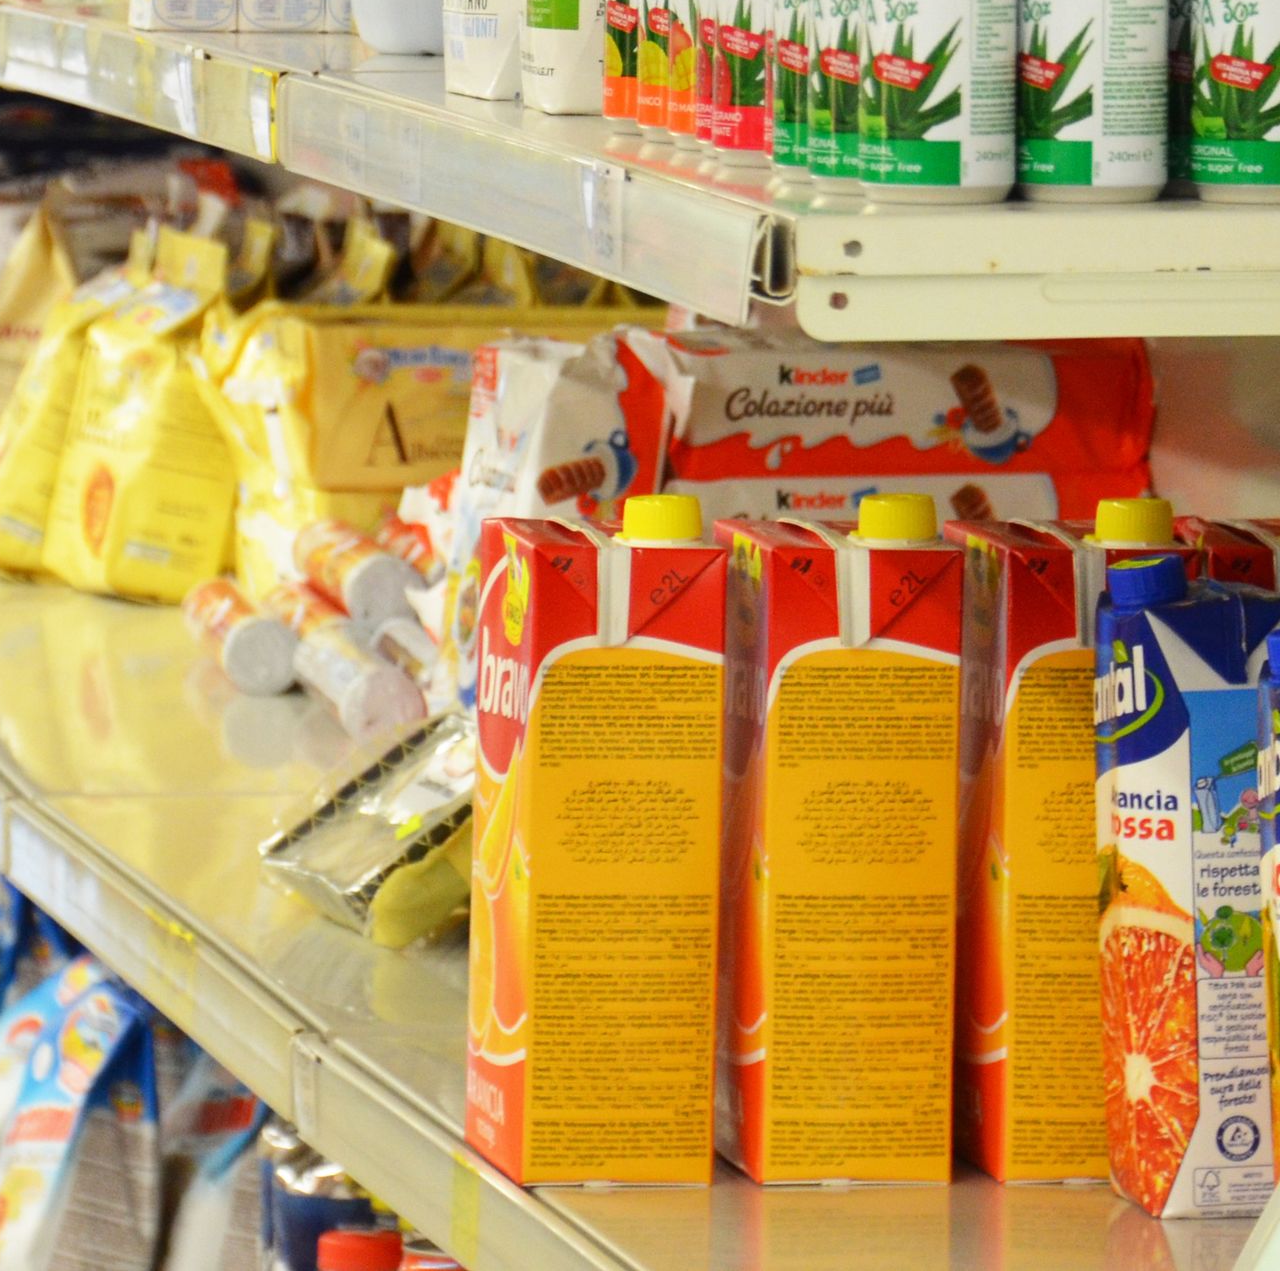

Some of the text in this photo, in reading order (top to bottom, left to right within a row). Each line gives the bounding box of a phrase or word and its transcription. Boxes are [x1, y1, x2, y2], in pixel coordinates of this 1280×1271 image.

[778, 364, 850, 386] kinder
[724, 387, 895, 427] Colazione più
[776, 488, 849, 511] kinder
[1196, 882, 1210, 898] le
[1209, 1079, 1262, 1096] cura delle
[1217, 1093, 1258, 1112] foreste!
